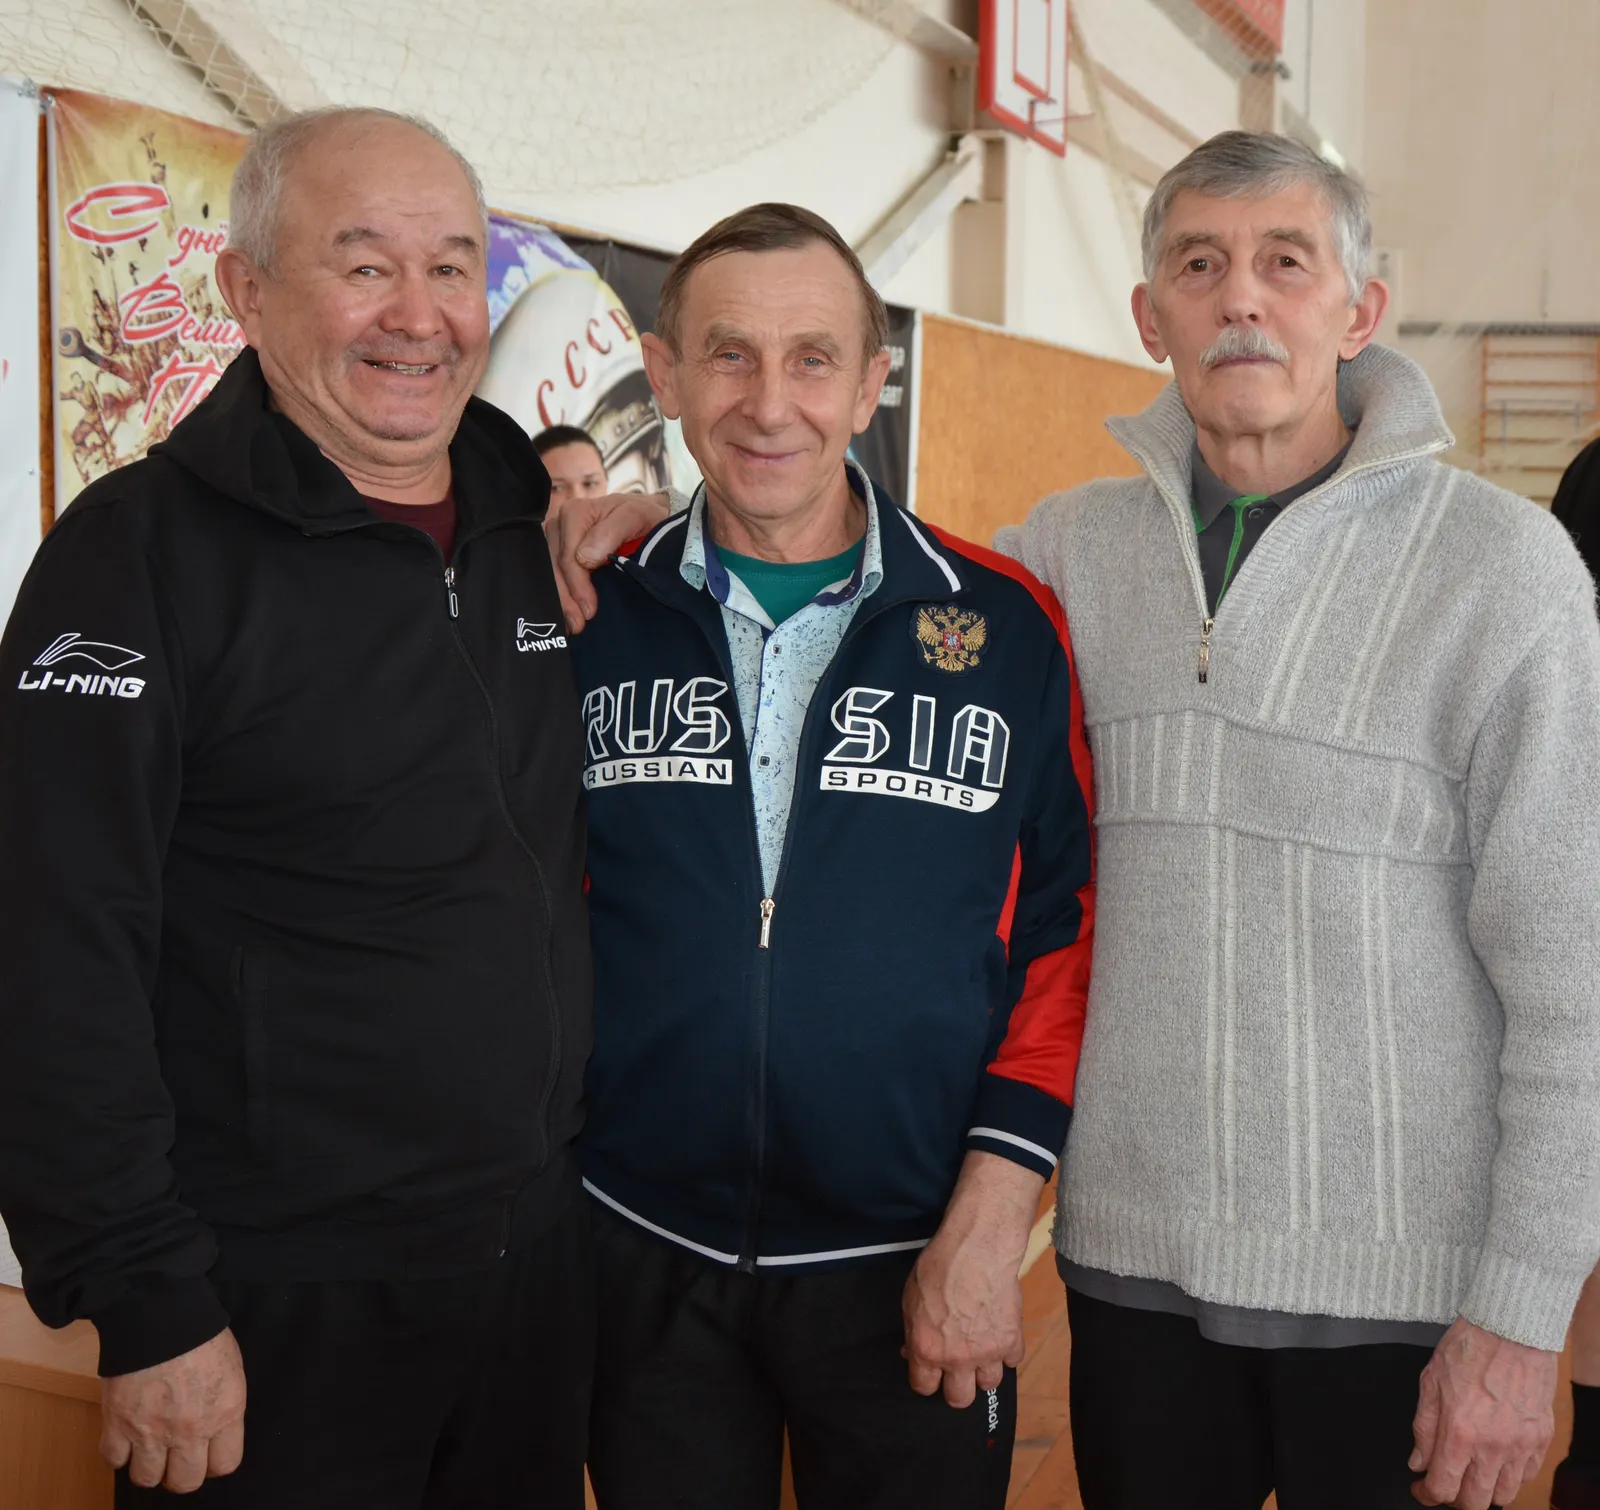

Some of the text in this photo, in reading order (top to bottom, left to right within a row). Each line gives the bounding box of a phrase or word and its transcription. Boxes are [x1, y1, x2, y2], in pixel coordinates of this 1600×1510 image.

[64, 182, 229, 267] С днё
[537, 307, 634, 428] СССР
[516, 636, 568, 652] LI-NING
[17, 670, 147, 699] LI-NING
[582, 676, 1011, 789] RUS SIA
[587, 761, 974, 808] RUSSIAN SPORTS
[986, 1387, 999, 1433] eebok
